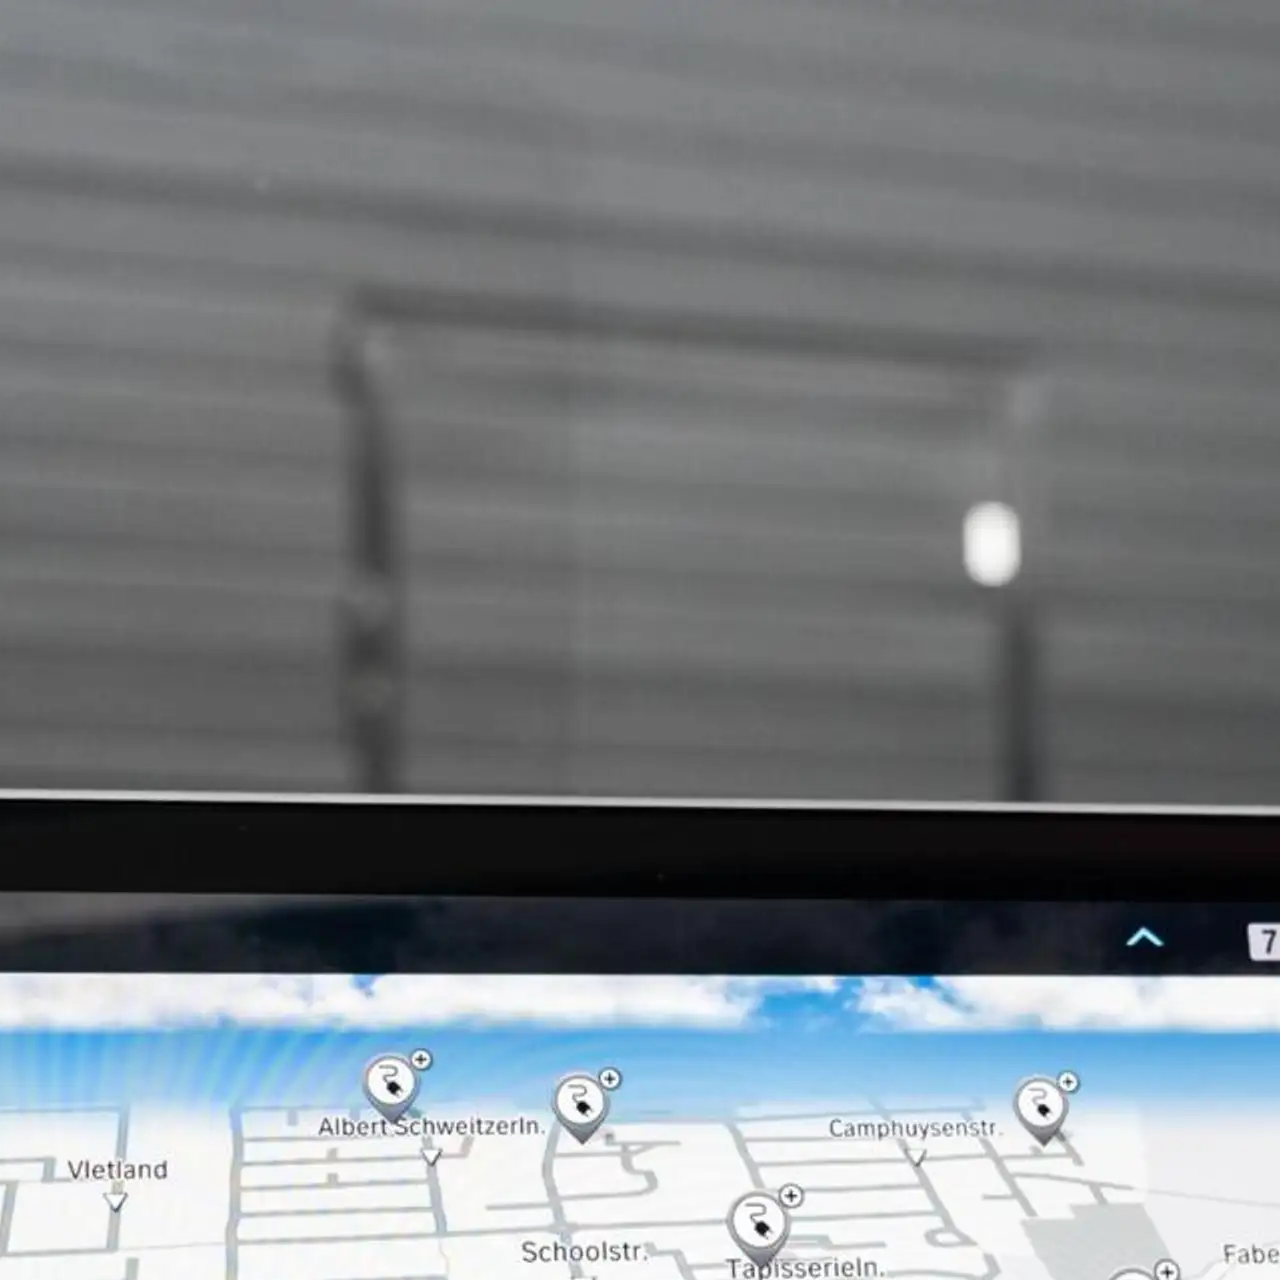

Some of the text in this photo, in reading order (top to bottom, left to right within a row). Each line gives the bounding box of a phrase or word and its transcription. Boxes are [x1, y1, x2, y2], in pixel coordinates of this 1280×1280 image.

[319, 1115, 388, 1138] Albert
[829, 1117, 1004, 1142] Camphuysenstr.
[521, 1239, 648, 1263] Schoolstr.
